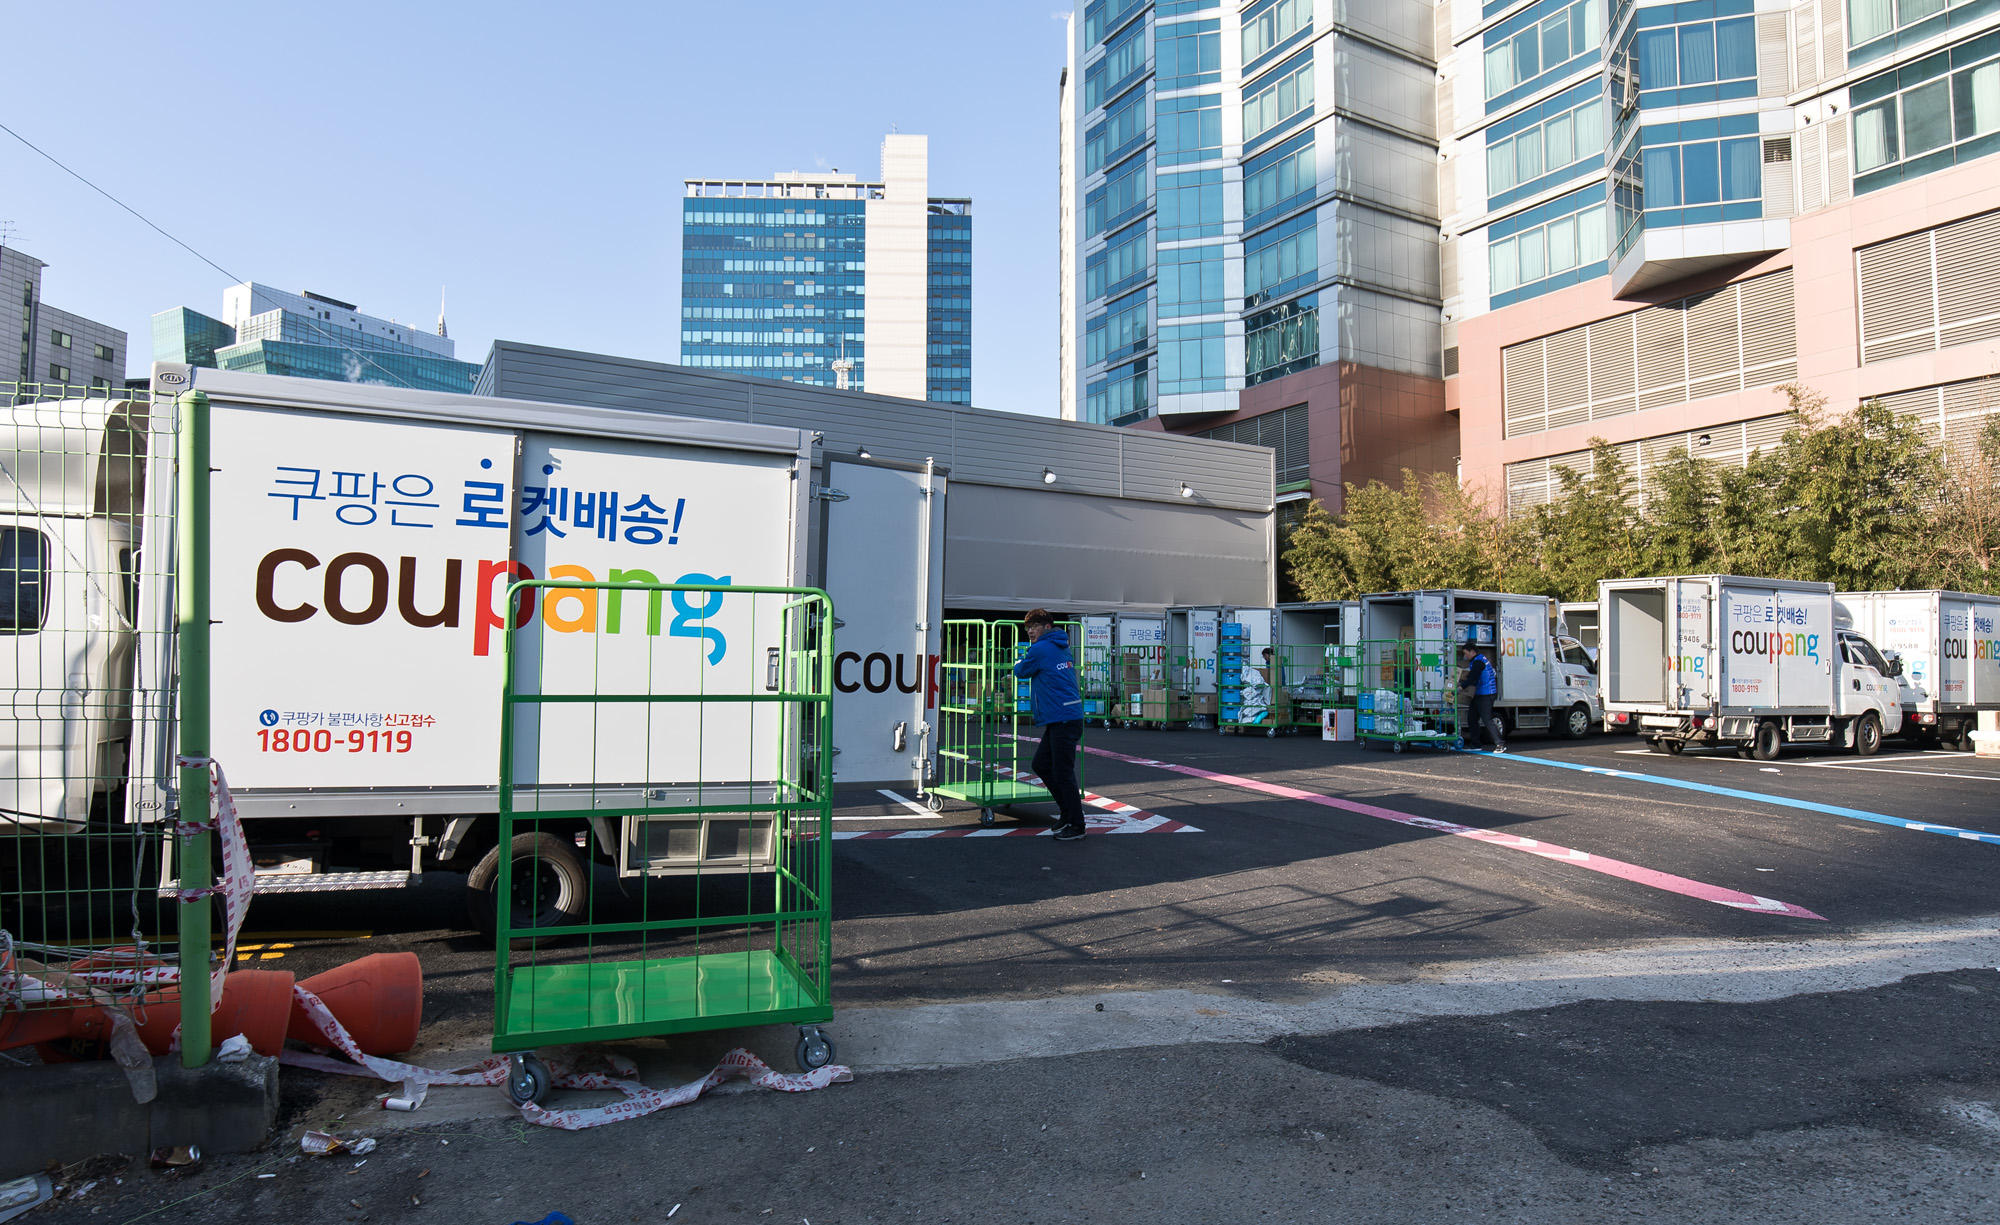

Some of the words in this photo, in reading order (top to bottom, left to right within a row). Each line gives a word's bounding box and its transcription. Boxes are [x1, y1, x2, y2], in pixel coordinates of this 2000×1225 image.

[160, 373, 183, 383] KIA
[267, 466, 441, 528] 쿠팡은
[455, 472, 687, 546] 로켓배송!
[255, 547, 732, 667] coupang
[1733, 604, 1762, 623] 쿠팡은
[1764, 604, 1808, 625] 로켓배송!
[1943, 615, 1963, 631] 쿠팡은
[1129, 628, 1153, 641] 쿠팡은
[1732, 630, 1819, 666] coupang
[281, 711, 324, 727] 쿠팡카
[327, 712, 383, 728] 불편사항
[384, 713, 436, 728] 신고접수
[256, 728, 413, 753] 1800-9119
